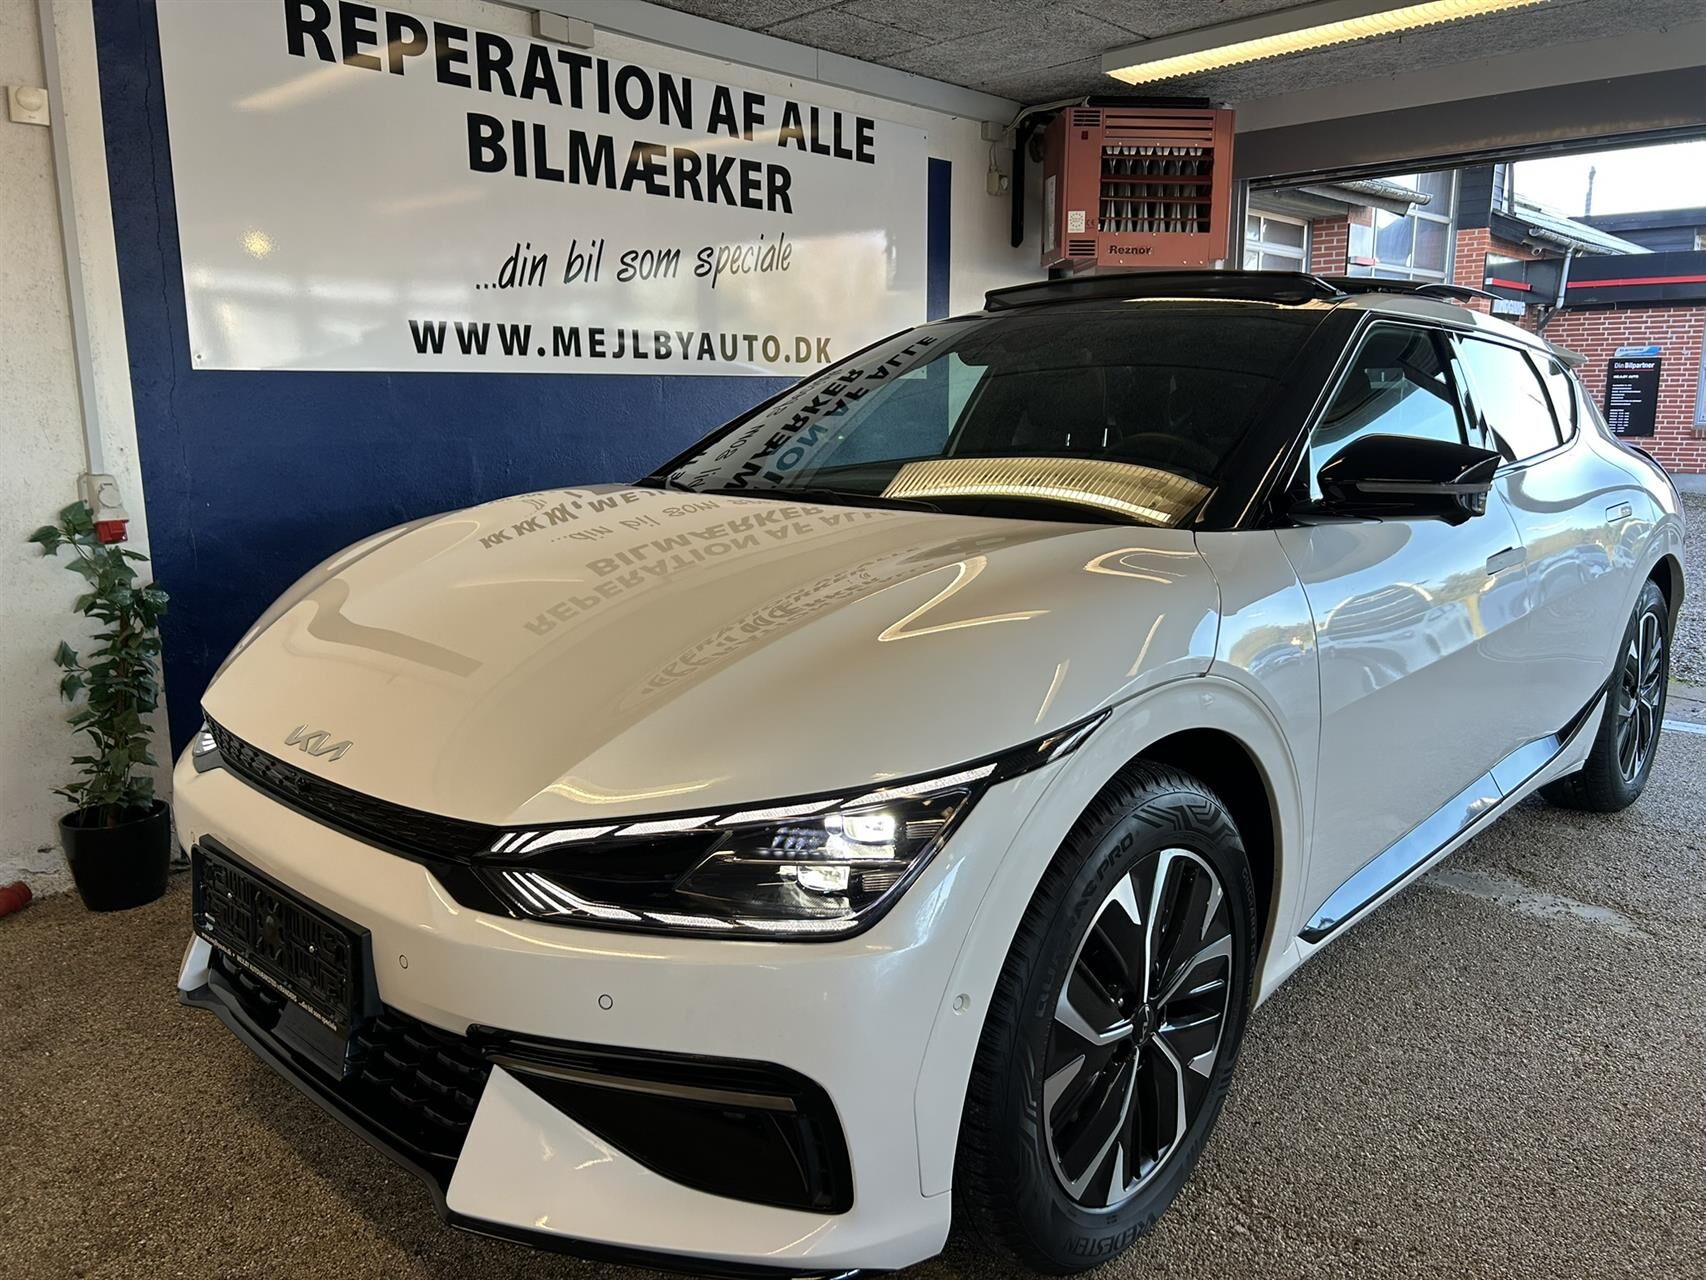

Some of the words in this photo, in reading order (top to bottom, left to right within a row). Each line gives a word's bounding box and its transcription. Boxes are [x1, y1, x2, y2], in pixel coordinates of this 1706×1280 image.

[284, 0, 692, 130] REPERATION
[707, 85, 765, 142] AF
[778, 101, 875, 164] ALLE
[467, 112, 793, 214] BILMÆRKER
[563, 239, 605, 284] bil
[617, 248, 680, 282] som
[694, 232, 792, 289] speciale
[1109, 245, 1151, 254] Reznor
[409, 319, 832, 364] WWW.MEJLBYAUTO.DK
[1097, 832, 1134, 881] PRO
